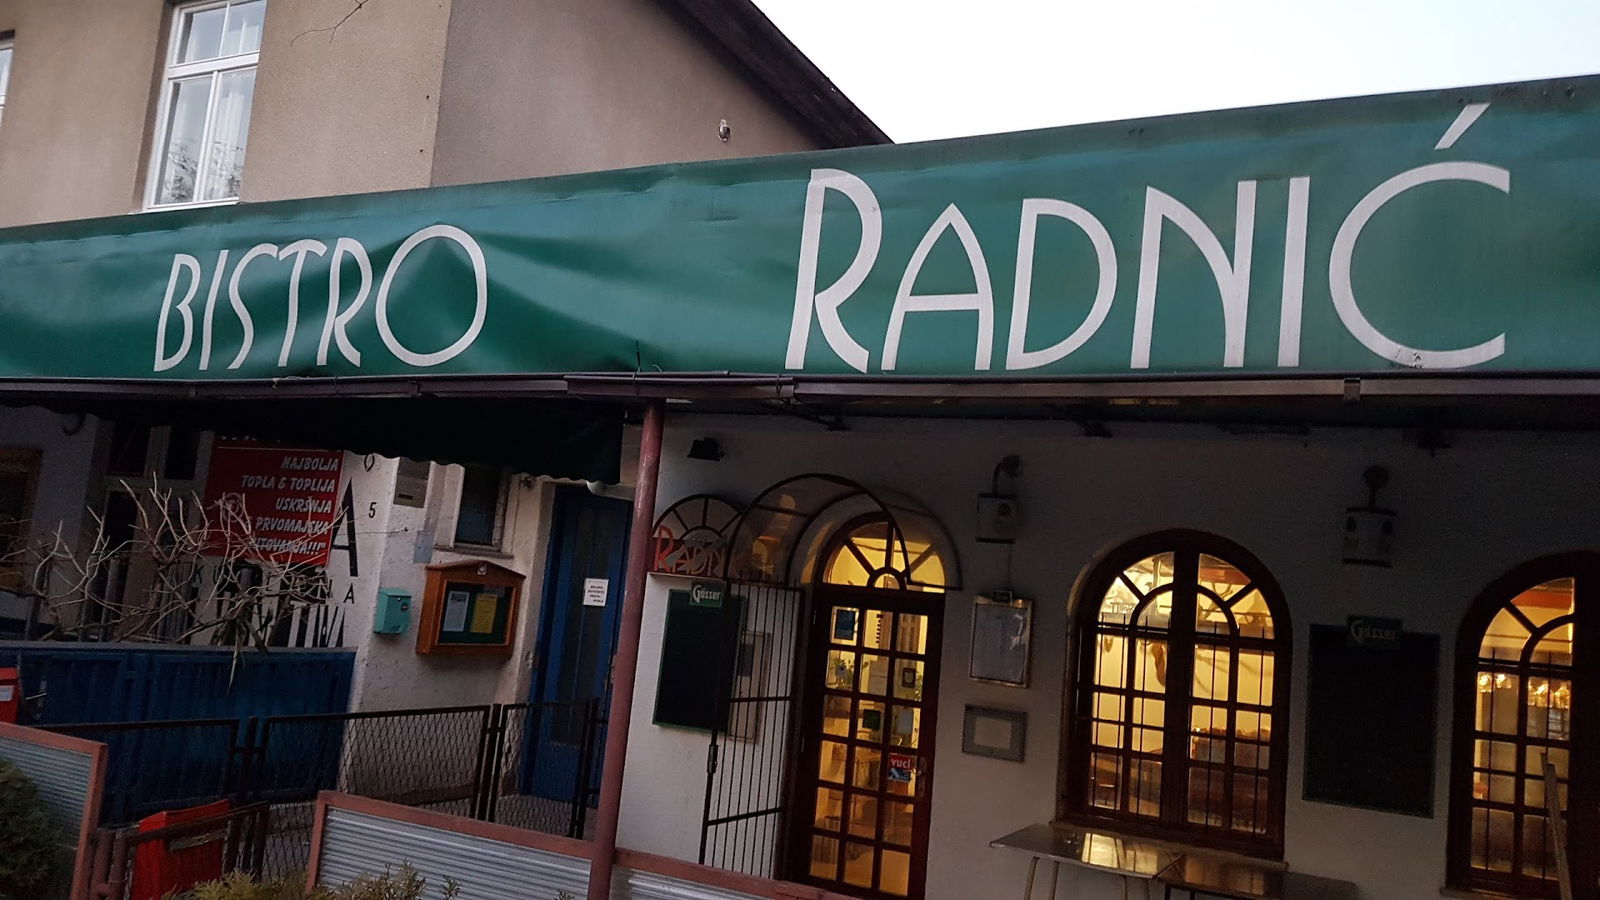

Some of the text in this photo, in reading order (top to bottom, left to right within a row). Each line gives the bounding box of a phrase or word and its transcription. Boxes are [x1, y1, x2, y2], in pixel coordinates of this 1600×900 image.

[153, 103, 1510, 373] BISTRO RADNIĆ
[281, 456, 339, 471] NAJBOLJA
[240, 474, 336, 493] TOPLA & TOPLIJA
[368, 502, 378, 518] 5
